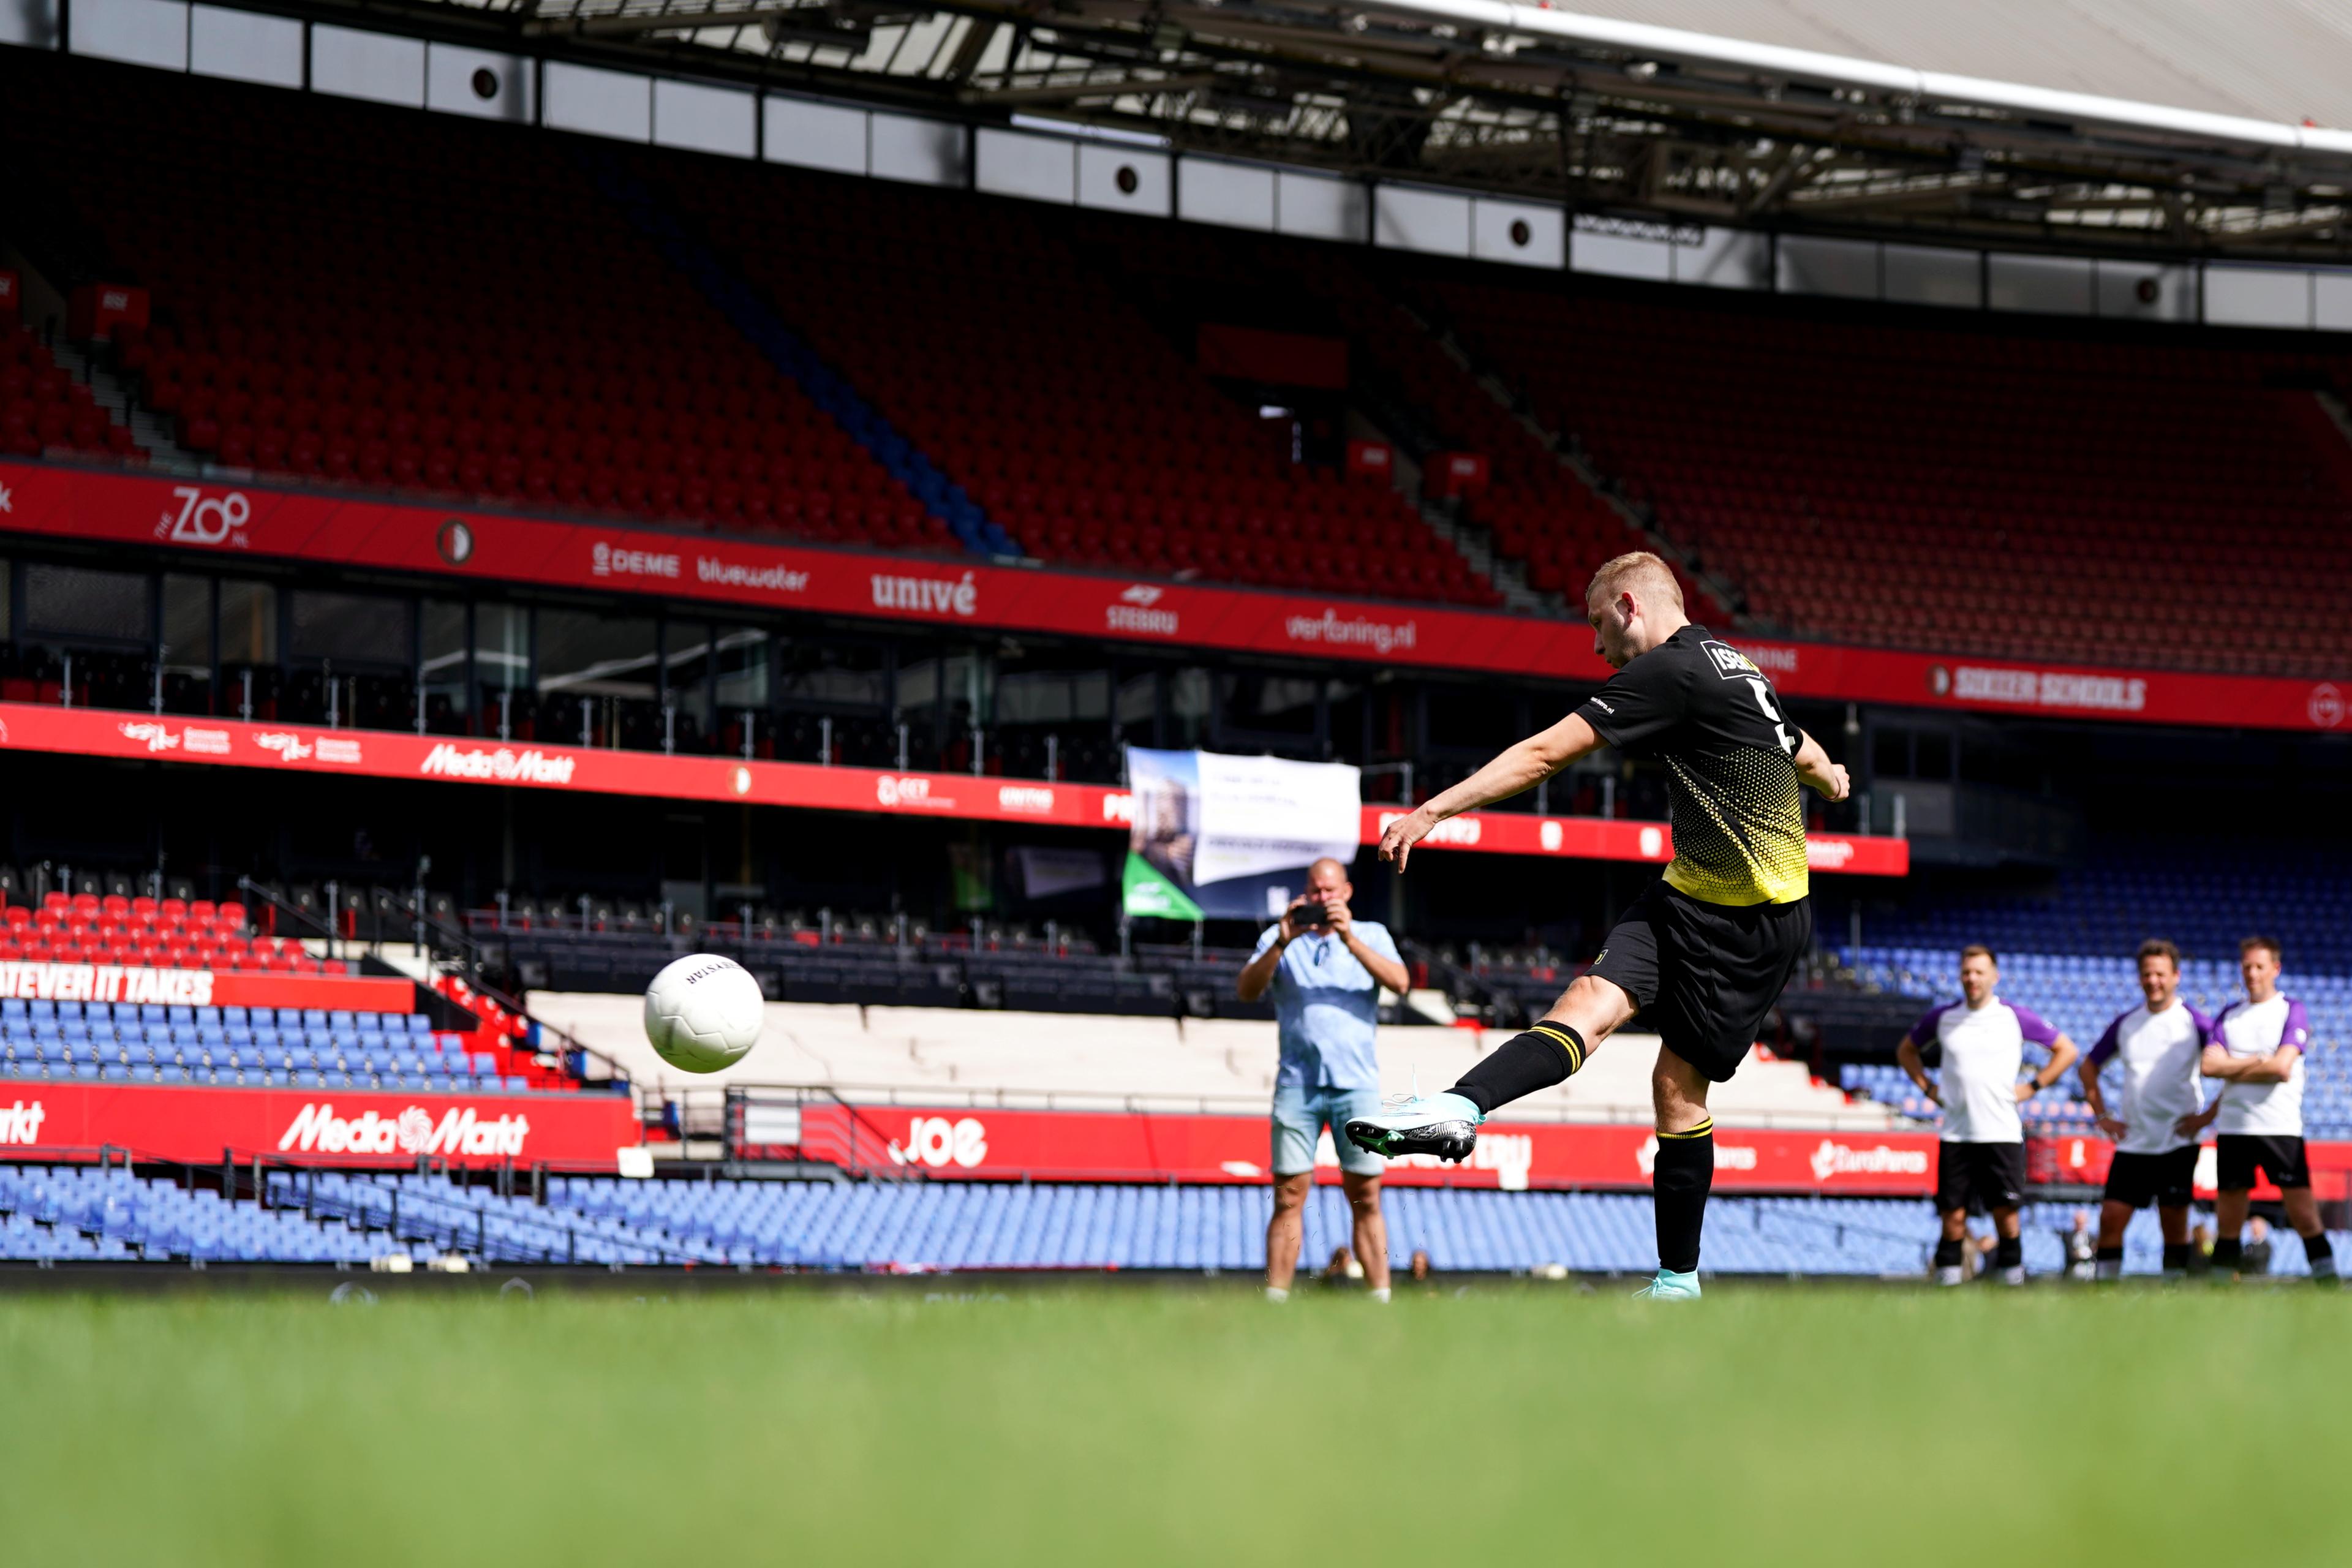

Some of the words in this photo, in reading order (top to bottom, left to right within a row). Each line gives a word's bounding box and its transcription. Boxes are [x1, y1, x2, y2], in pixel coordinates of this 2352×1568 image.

[612, 549, 680, 578] DEME
[697, 556, 810, 591] bluewater
[870, 570, 978, 616] univé
[1954, 666, 2037, 704] SOCCER
[2040, 672, 2147, 711] SCHOOLS
[0, 960, 94, 1002] TEVER
[95, 965, 124, 1002] IT
[124, 967, 214, 1006] TAKES
[0, 1100, 45, 1144] rkt
[278, 1102, 396, 1154] Media
[427, 1107, 530, 1156] Markt
